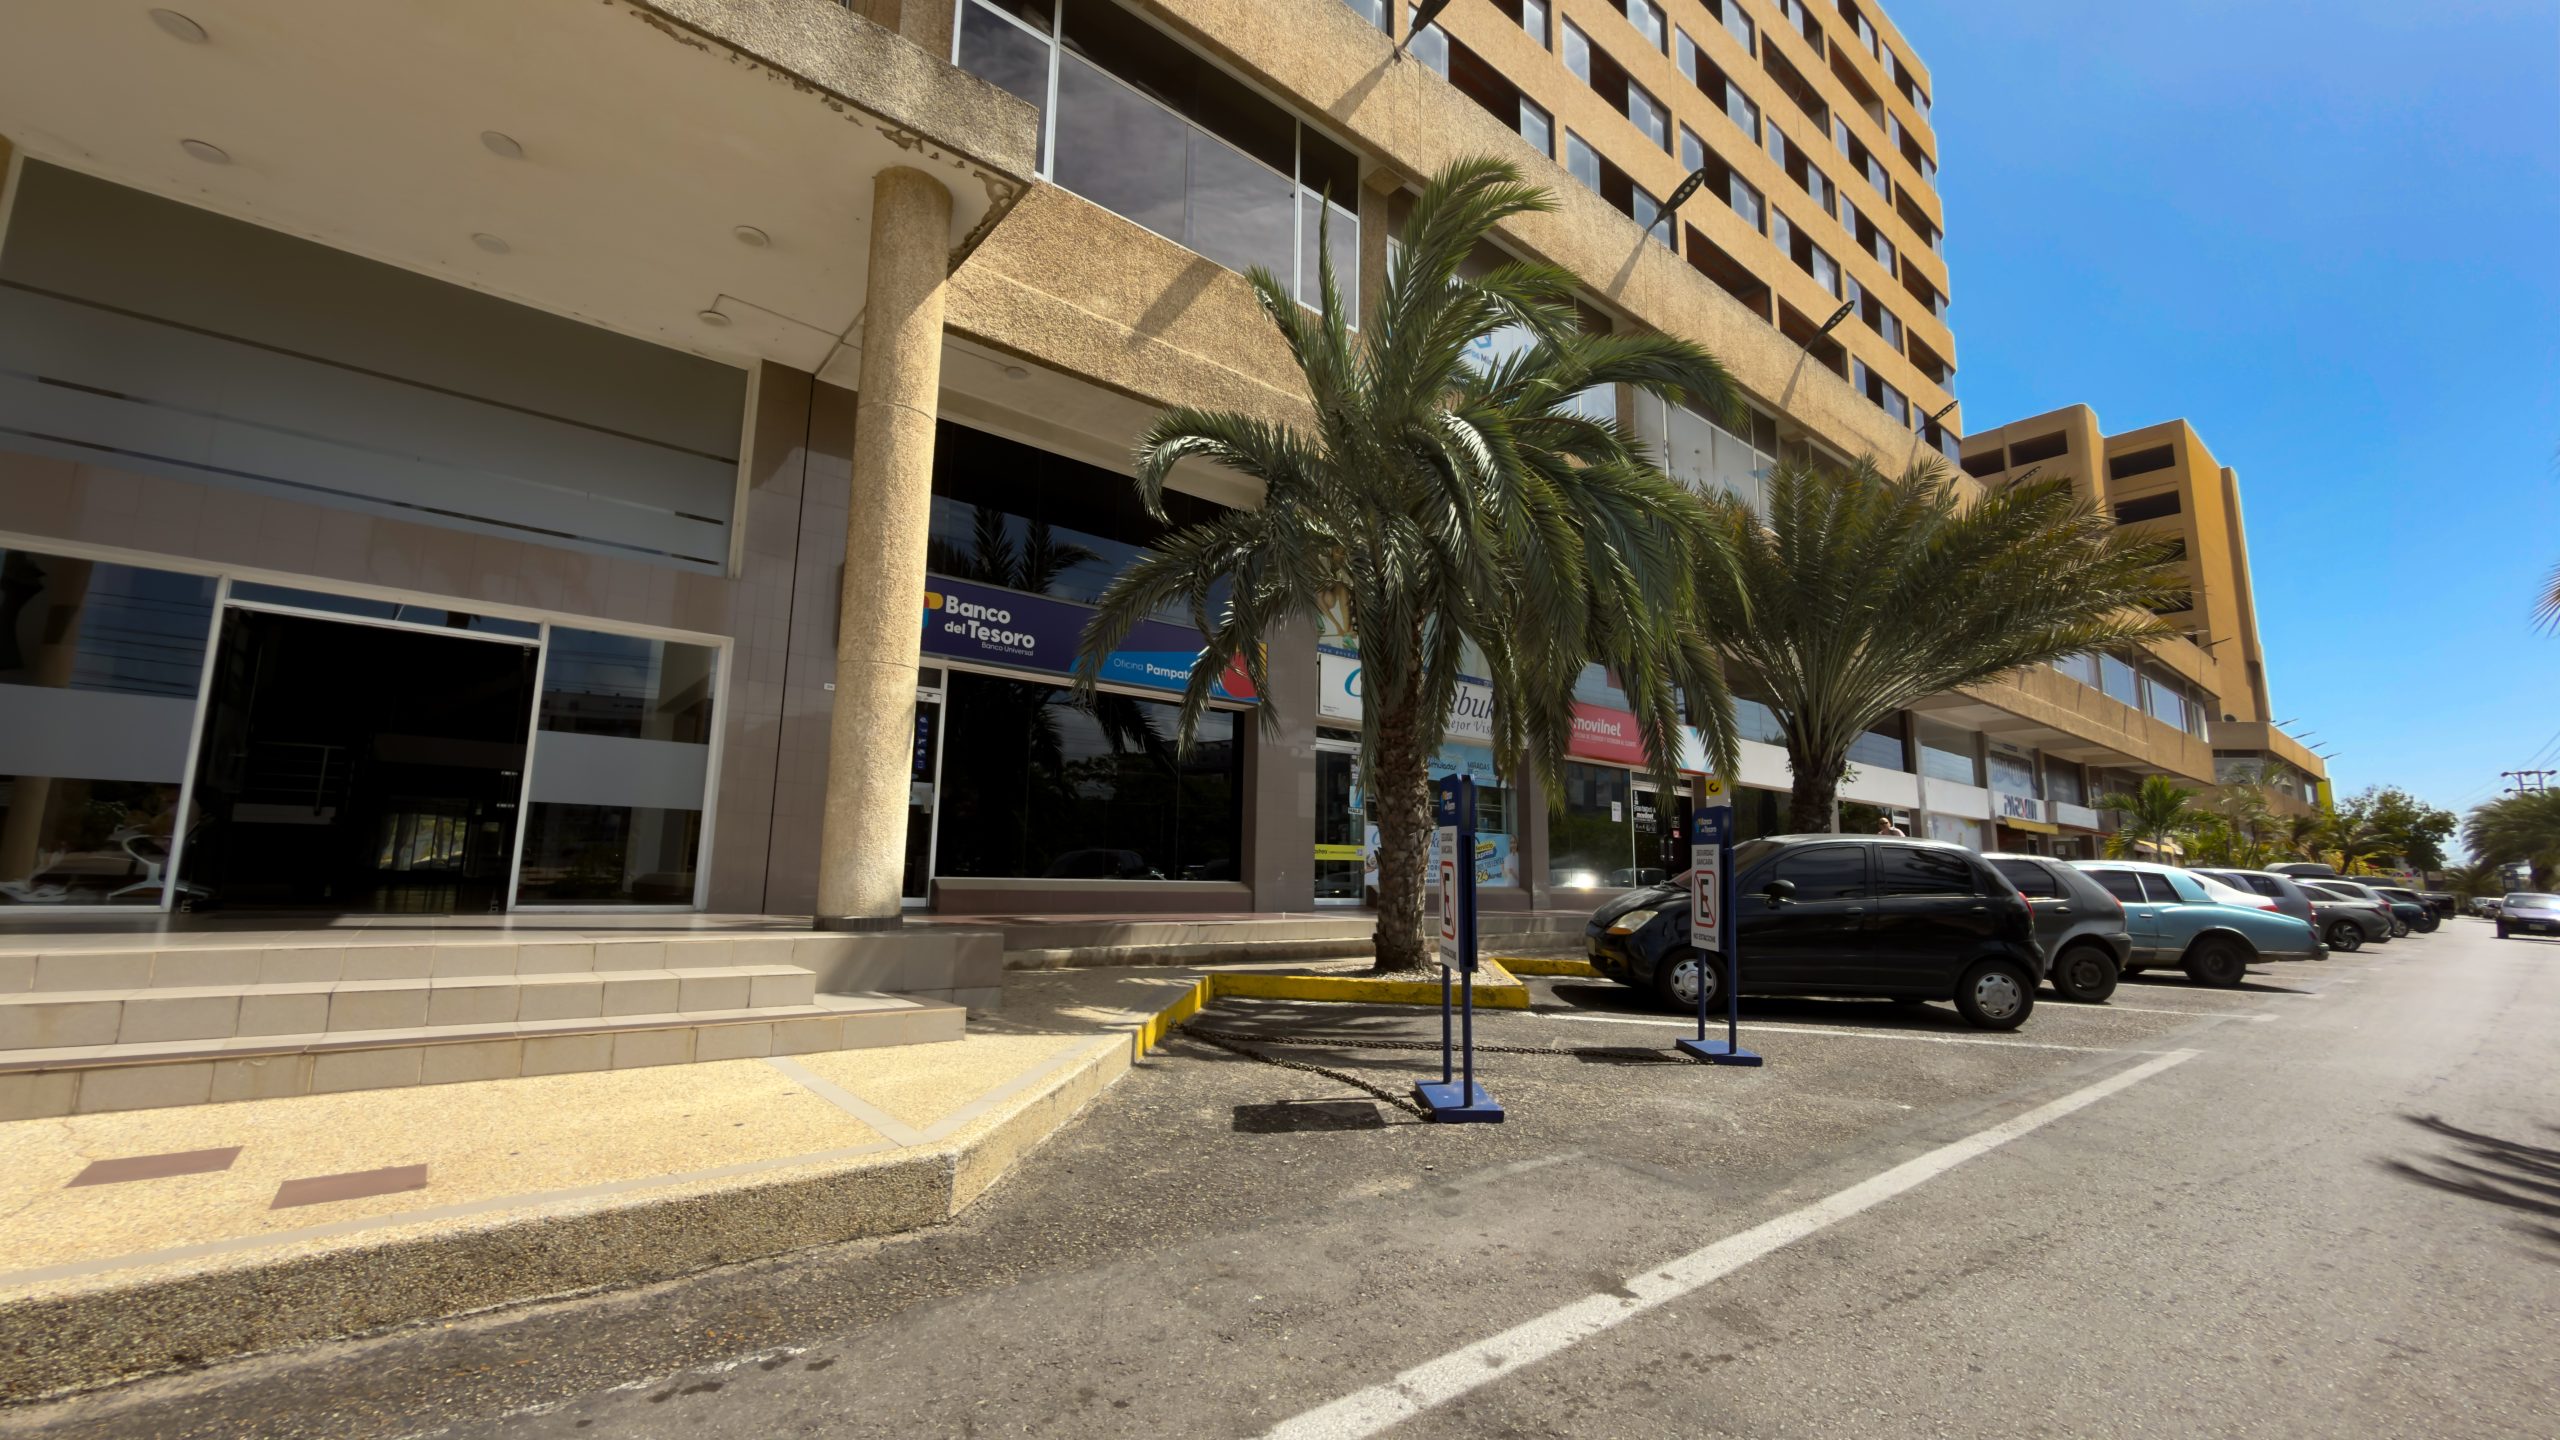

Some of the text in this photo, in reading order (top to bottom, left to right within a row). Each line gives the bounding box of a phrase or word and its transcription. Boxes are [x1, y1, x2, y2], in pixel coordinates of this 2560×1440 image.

[945, 594, 1011, 624] Banco
[944, 620, 1035, 649] del Tesoro
[981, 641, 1034, 657] Banco Universal
[1113, 658, 1191, 680] Oficina Pampat
[1450, 719, 1471, 733] ejor
[1573, 717, 1621, 737] movilnet
